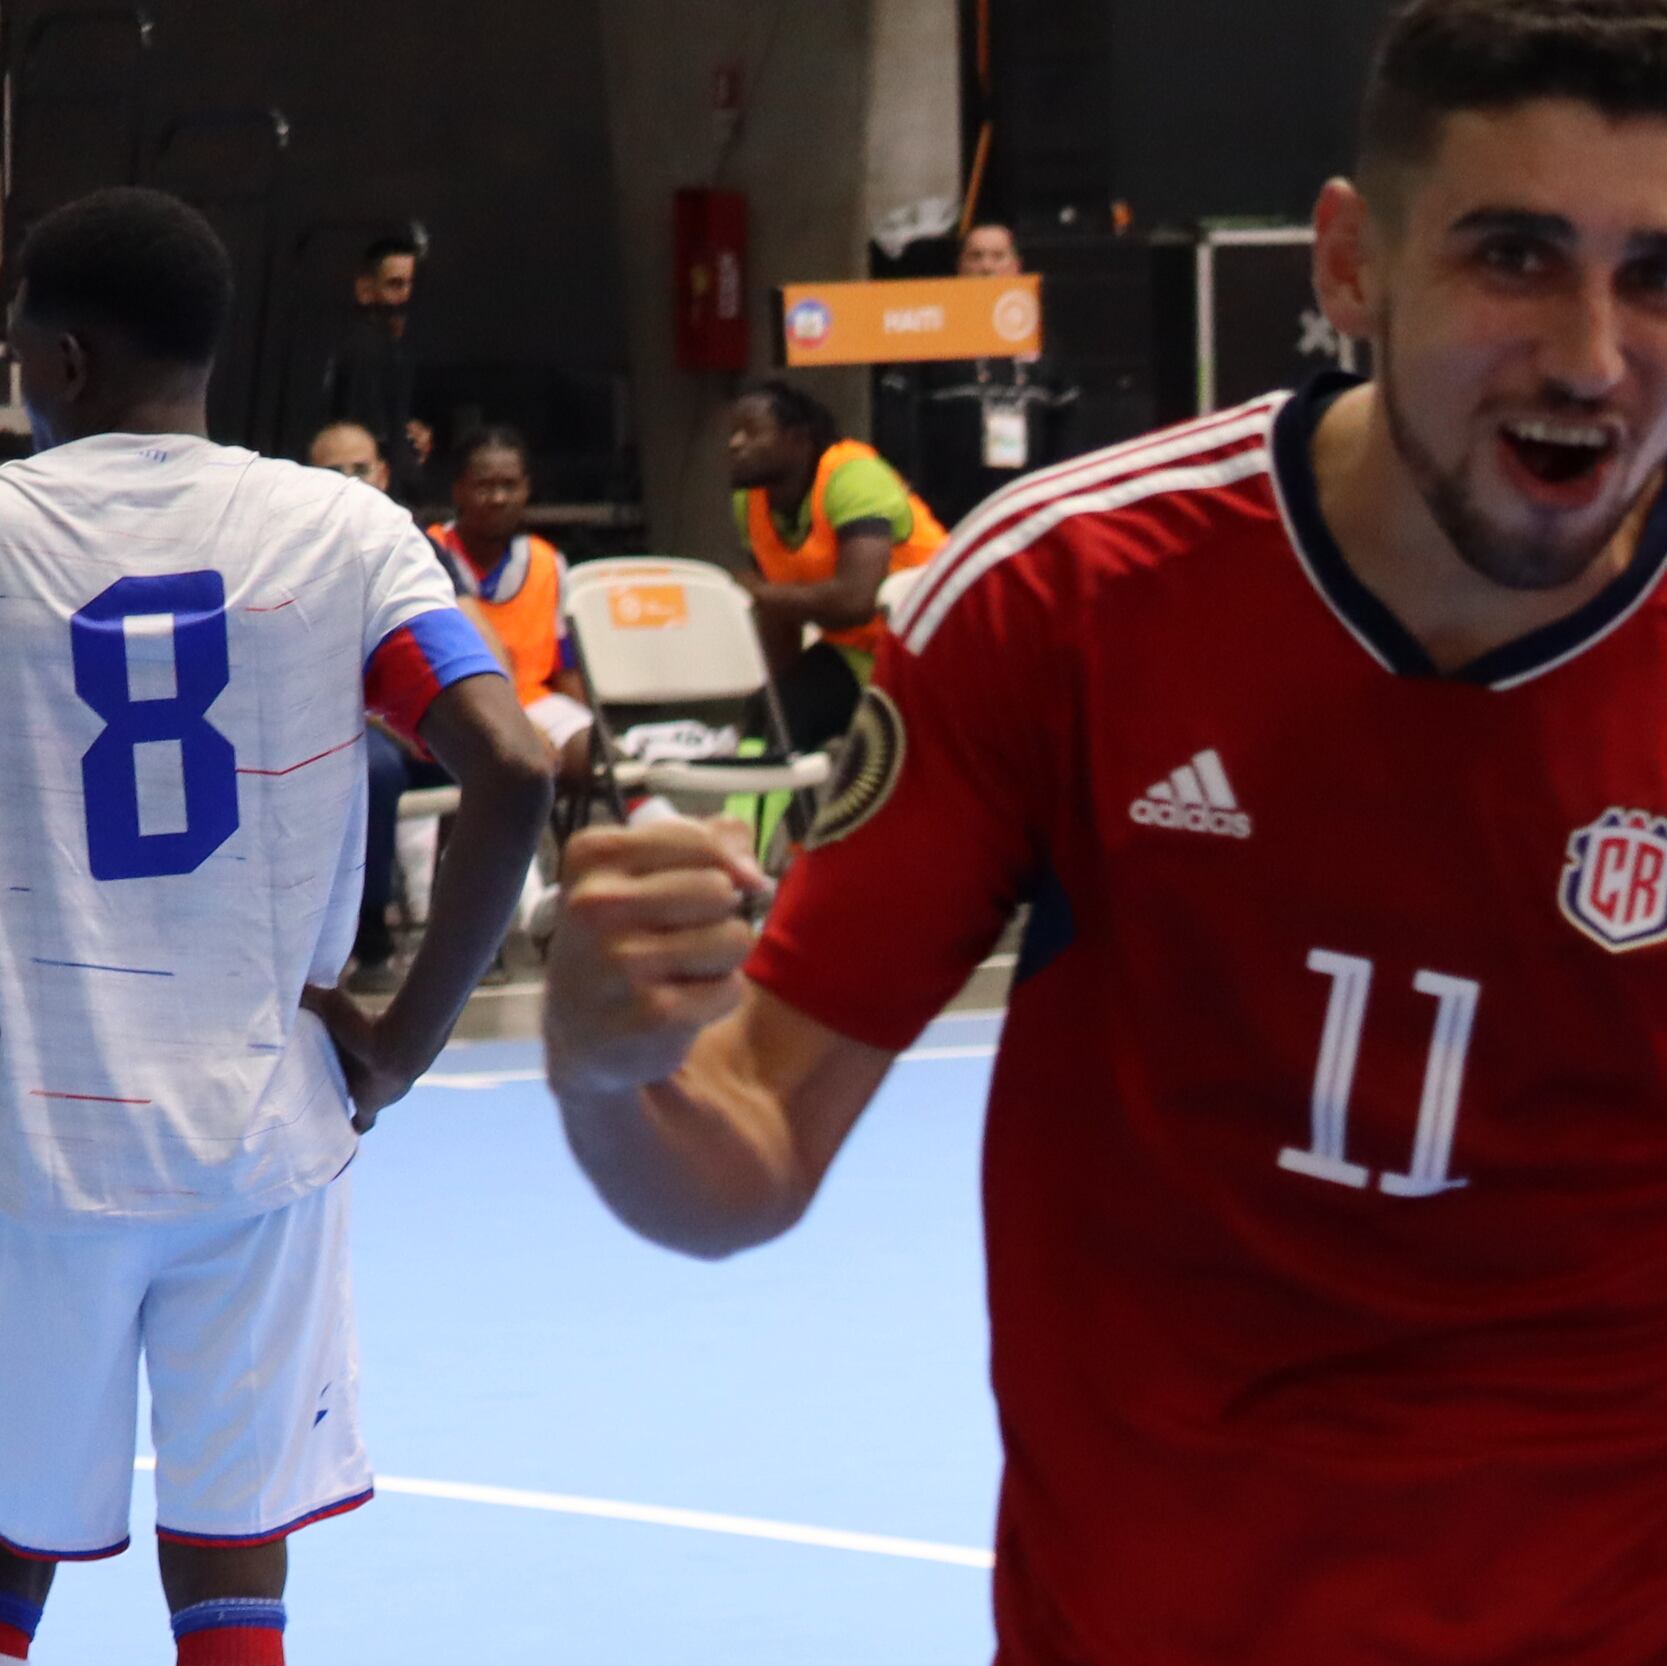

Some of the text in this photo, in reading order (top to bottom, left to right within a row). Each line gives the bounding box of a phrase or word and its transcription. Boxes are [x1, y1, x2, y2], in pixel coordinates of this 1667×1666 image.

[71, 570, 238, 881] 8
[1129, 798, 1251, 839] adidas
[1588, 836, 1664, 925] CR
[1278, 947, 1481, 1197] 11
